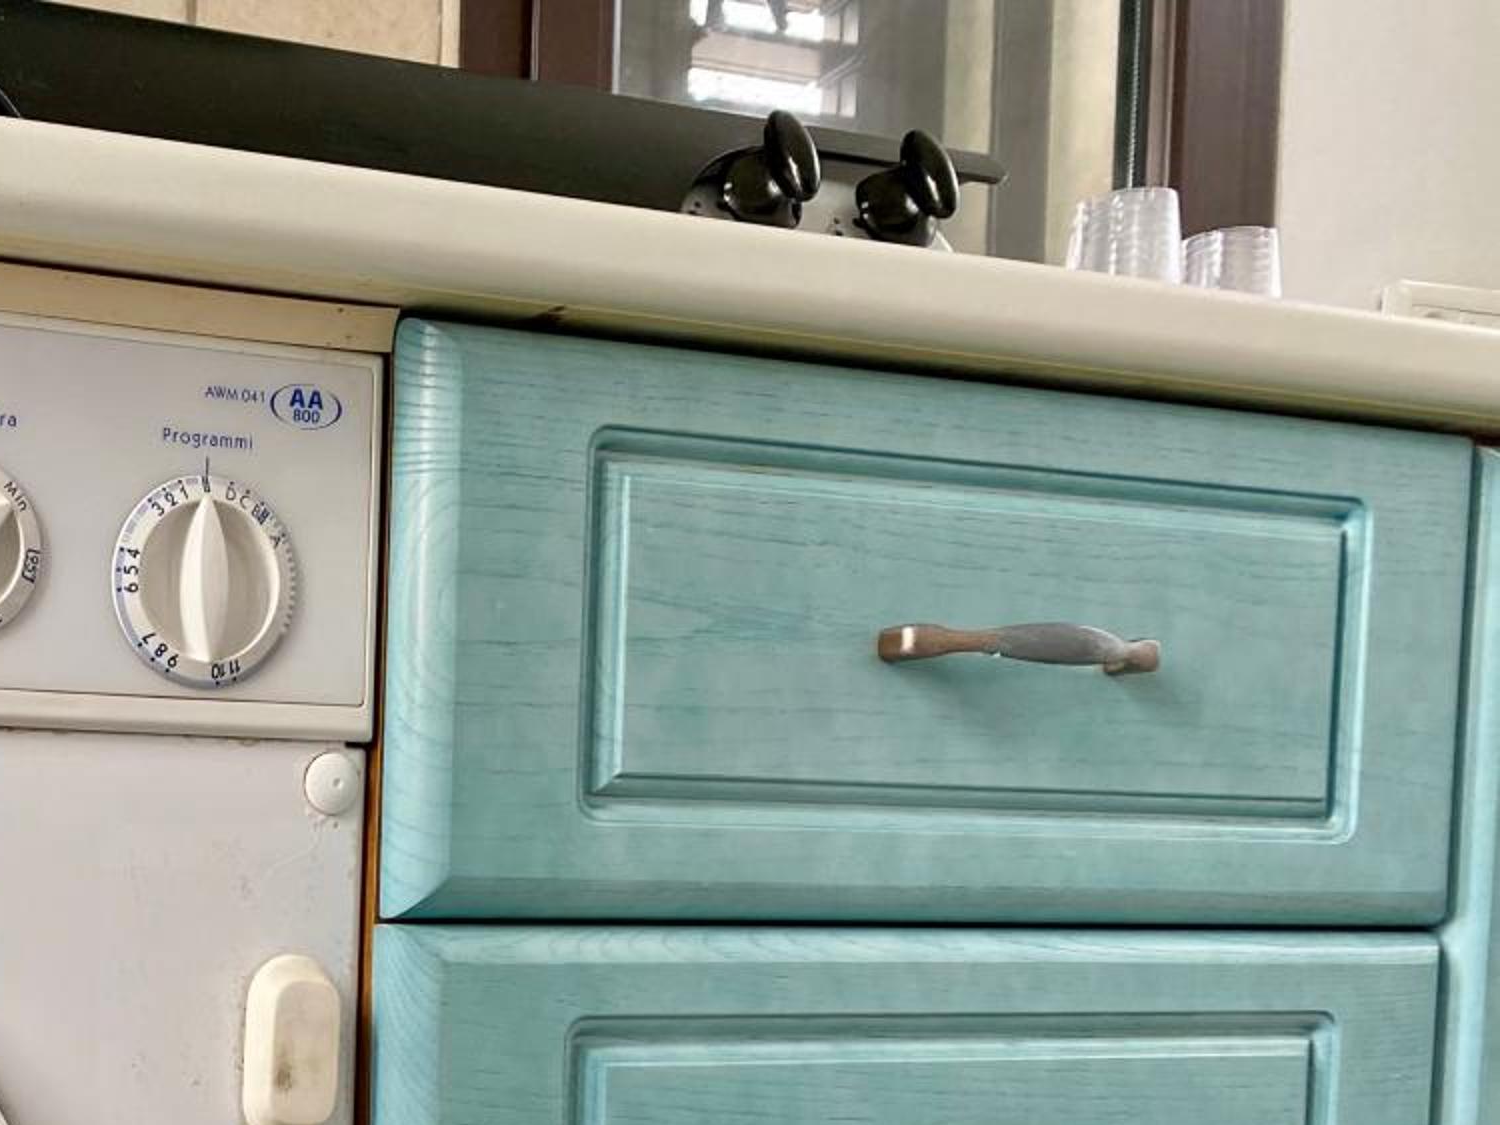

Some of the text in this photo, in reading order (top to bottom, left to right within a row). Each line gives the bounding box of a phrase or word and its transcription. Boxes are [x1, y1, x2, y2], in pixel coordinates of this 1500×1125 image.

[290, 388, 324, 410] AA
[163, 427, 254, 450] Programmi
[4, 481, 27, 512] Min
